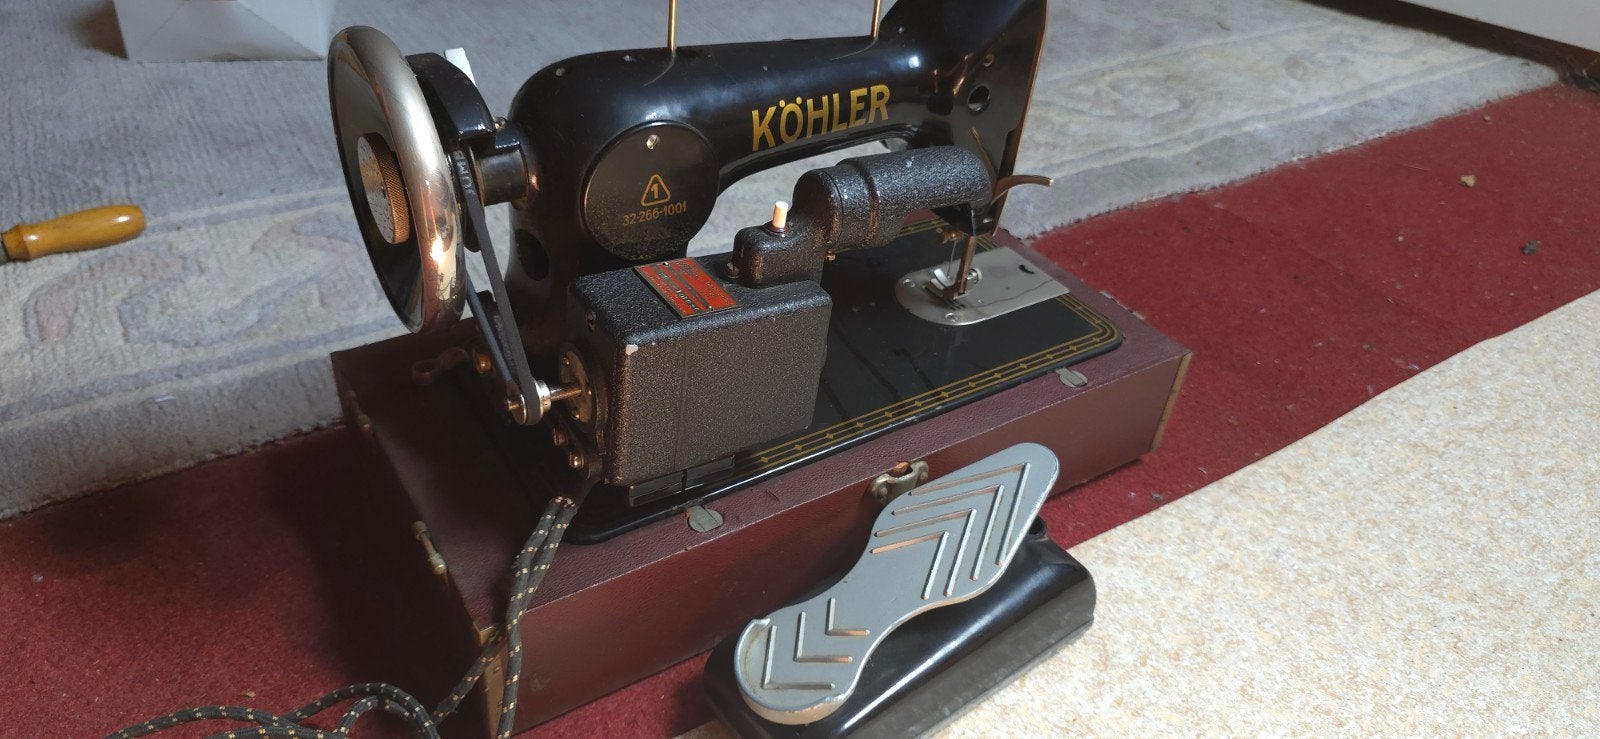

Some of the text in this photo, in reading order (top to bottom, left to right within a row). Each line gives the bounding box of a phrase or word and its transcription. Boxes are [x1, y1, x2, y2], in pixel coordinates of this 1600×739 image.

[752, 84, 890, 151] KÖHLER
[651, 183, 659, 199] 1
[623, 201, 687, 226] 32-266-1001
